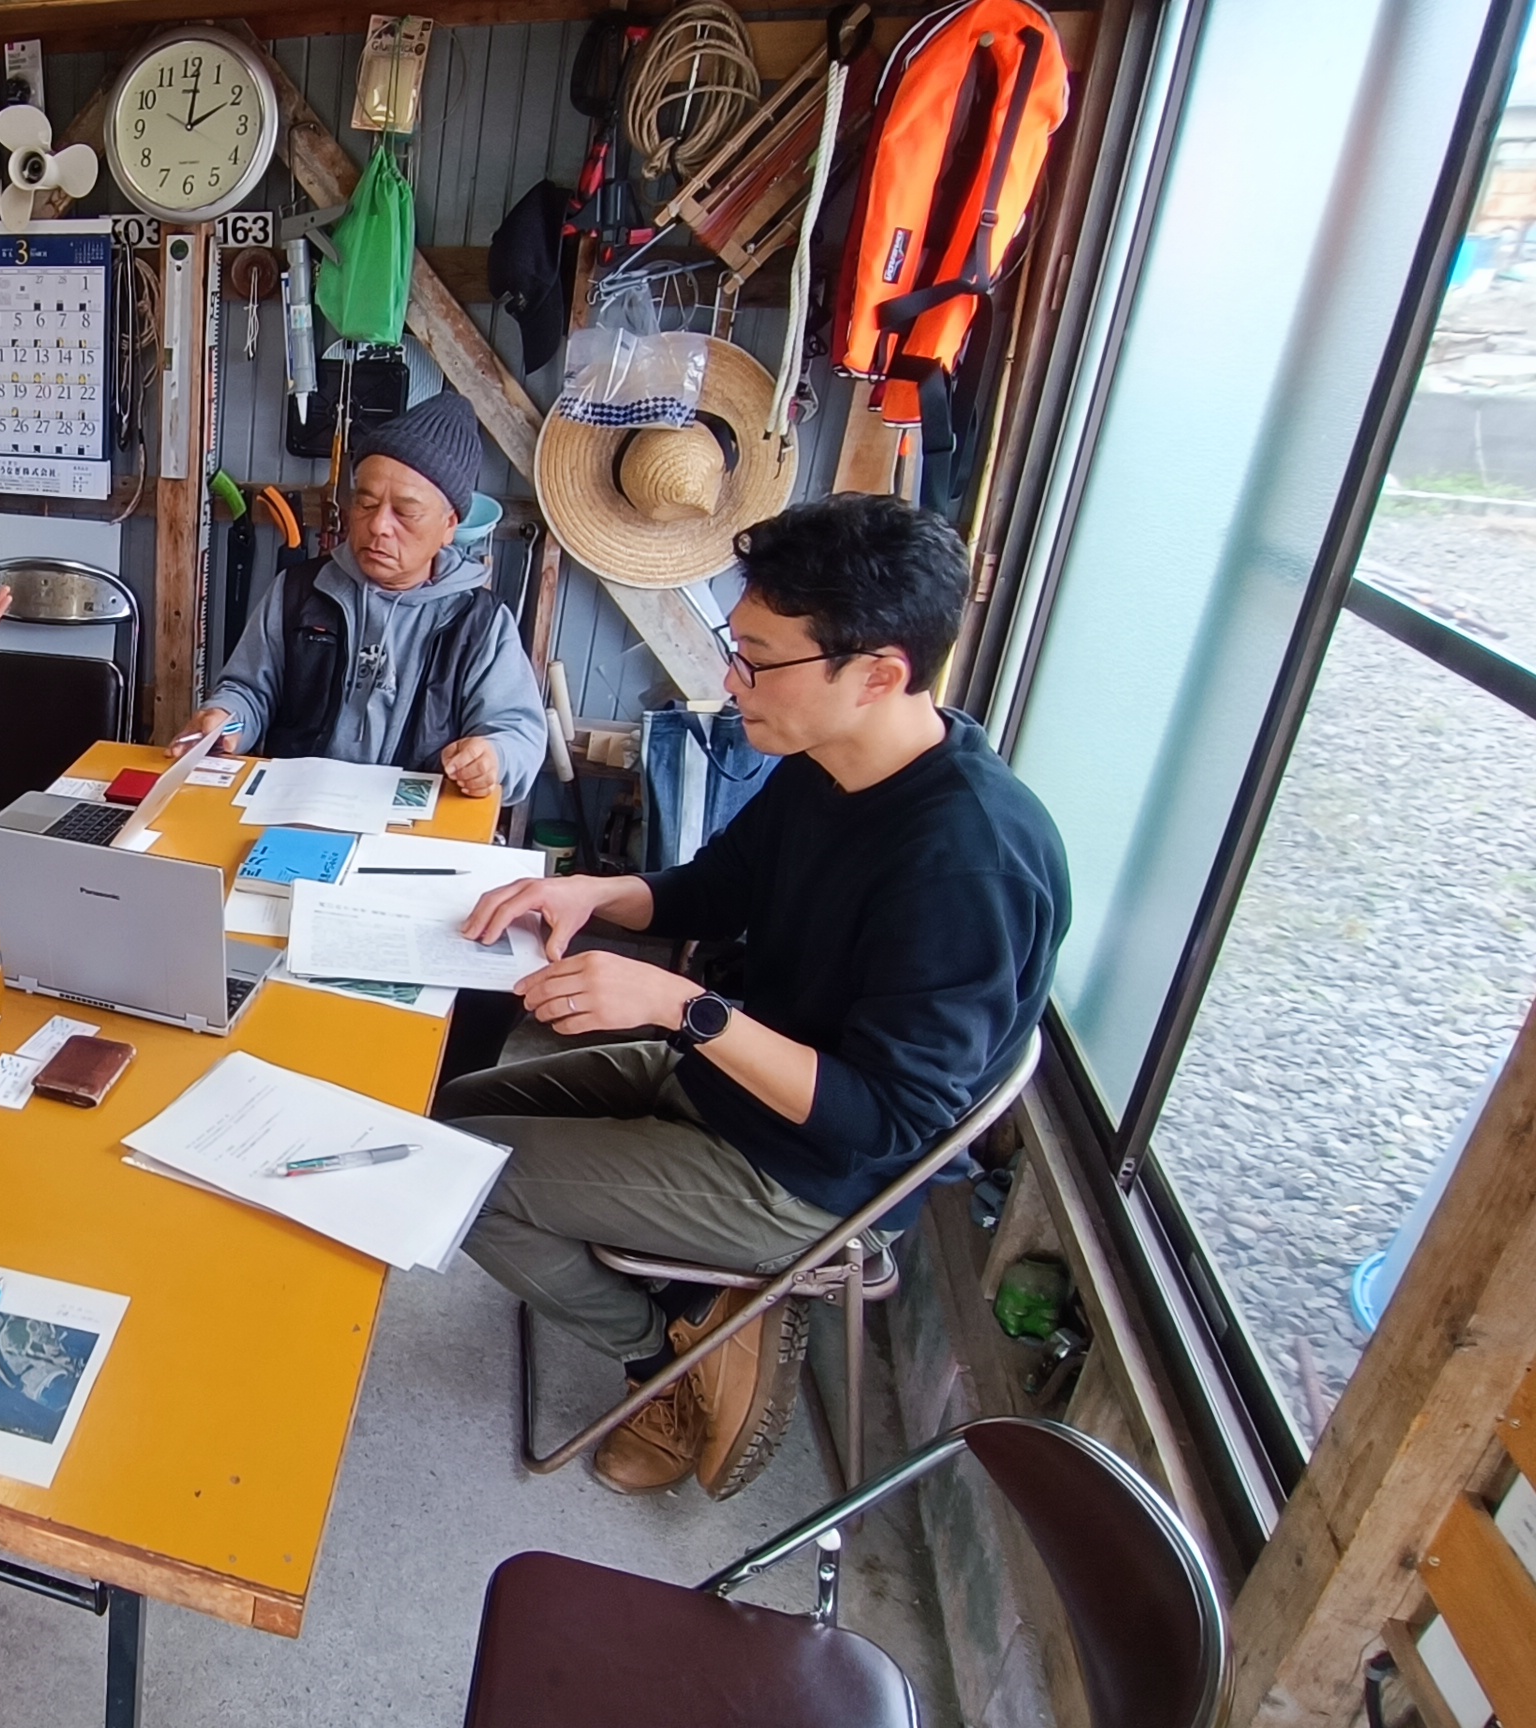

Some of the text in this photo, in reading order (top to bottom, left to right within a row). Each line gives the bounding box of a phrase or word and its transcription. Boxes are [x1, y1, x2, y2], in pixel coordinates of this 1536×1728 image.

[157, 66, 173, 88] 11
[181, 57, 203, 79] 12
[213, 64, 221, 85] 1
[137, 89, 156, 111] 10
[230, 85, 243, 106] 2
[133, 118, 145, 139] 9
[236, 114, 248, 136] 3
[140, 147, 151, 168] 8
[228, 145, 239, 165] 4
[158, 168, 170, 188] 7
[182, 174, 194, 195] 6
[208, 167, 220, 187] 5
[218, 215, 270, 245] 163
[15, 239, 28, 265] 3
[15, 313, 22, 327] 5
[36, 313, 45, 327] 6
[58, 313, 67, 327] 7
[82, 314, 91, 328] 8
[13, 349, 27, 363] 12
[36, 349, 50, 363] 13
[58, 350, 72, 364] 14
[81, 350, 95, 364] 15
[14, 384, 27, 398] 19
[35, 385, 51, 399] 20
[57, 385, 72, 399] 21
[80, 386, 95, 400] 22
[13, 419, 29, 433] 26
[35, 420, 50, 434] 27
[57, 421, 73, 435] 28
[79, 421, 95, 436] 29
[80, 886, 120, 900] Panasonic
